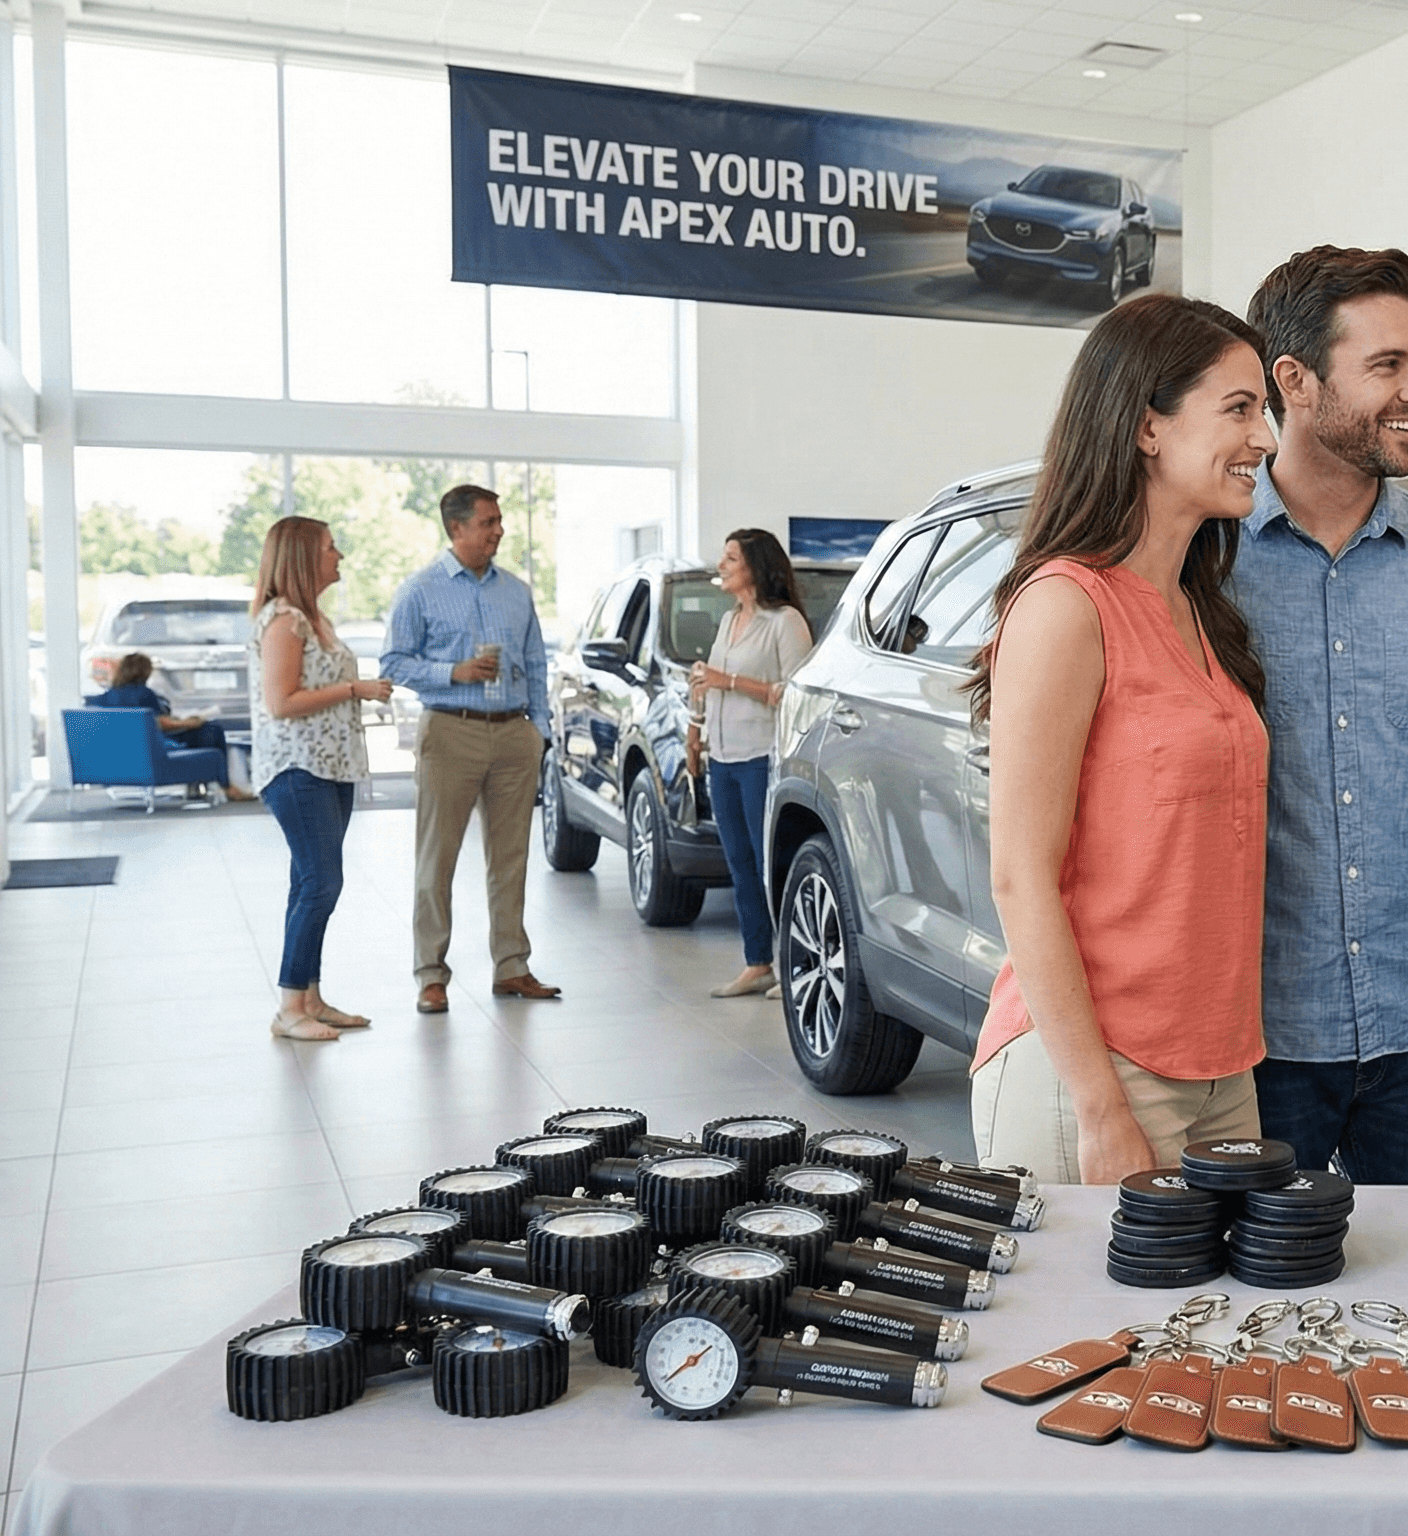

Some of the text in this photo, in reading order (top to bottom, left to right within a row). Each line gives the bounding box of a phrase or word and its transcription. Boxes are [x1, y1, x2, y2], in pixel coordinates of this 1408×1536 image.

[488, 128, 939, 215] ELEVATE YOUR DRIVE
[487, 182, 867, 258] WITH APEX AUTO.
